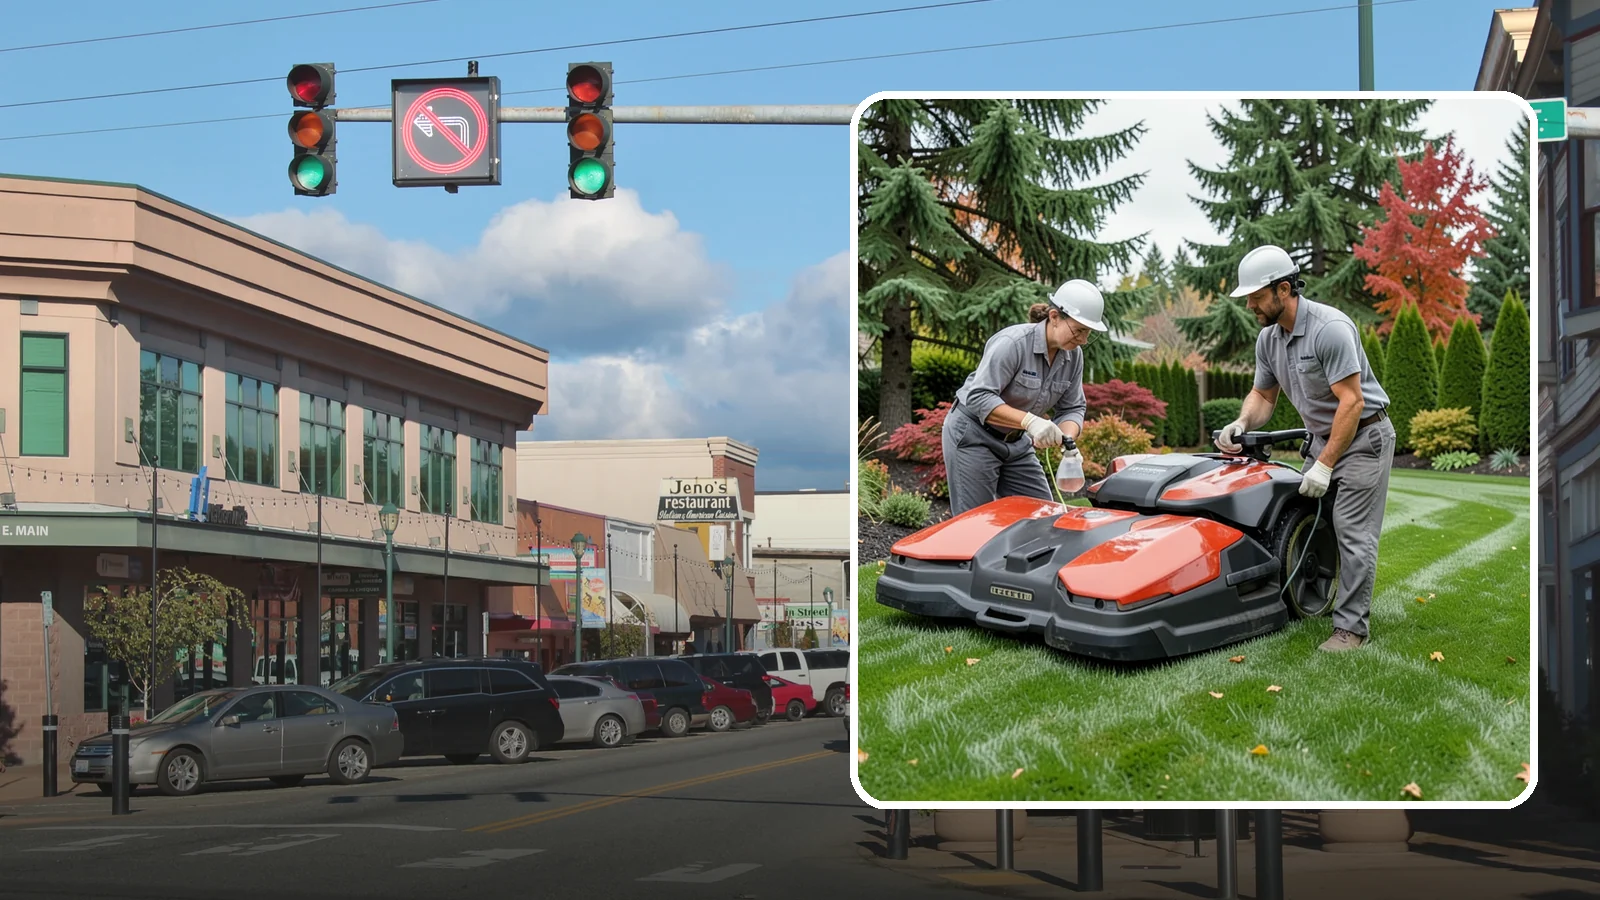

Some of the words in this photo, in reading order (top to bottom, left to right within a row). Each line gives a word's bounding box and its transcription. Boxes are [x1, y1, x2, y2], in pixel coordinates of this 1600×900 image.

[670, 480, 727, 494] Jeno's
[665, 496, 731, 509] restaurant
[658, 510, 681, 519] Italian
[686, 510, 714, 519] American
[715, 509, 738, 519] Cuisine
[2, 525, 13, 536] E.
[15, 525, 49, 536] MAIN
[797, 607, 829, 617] Street
